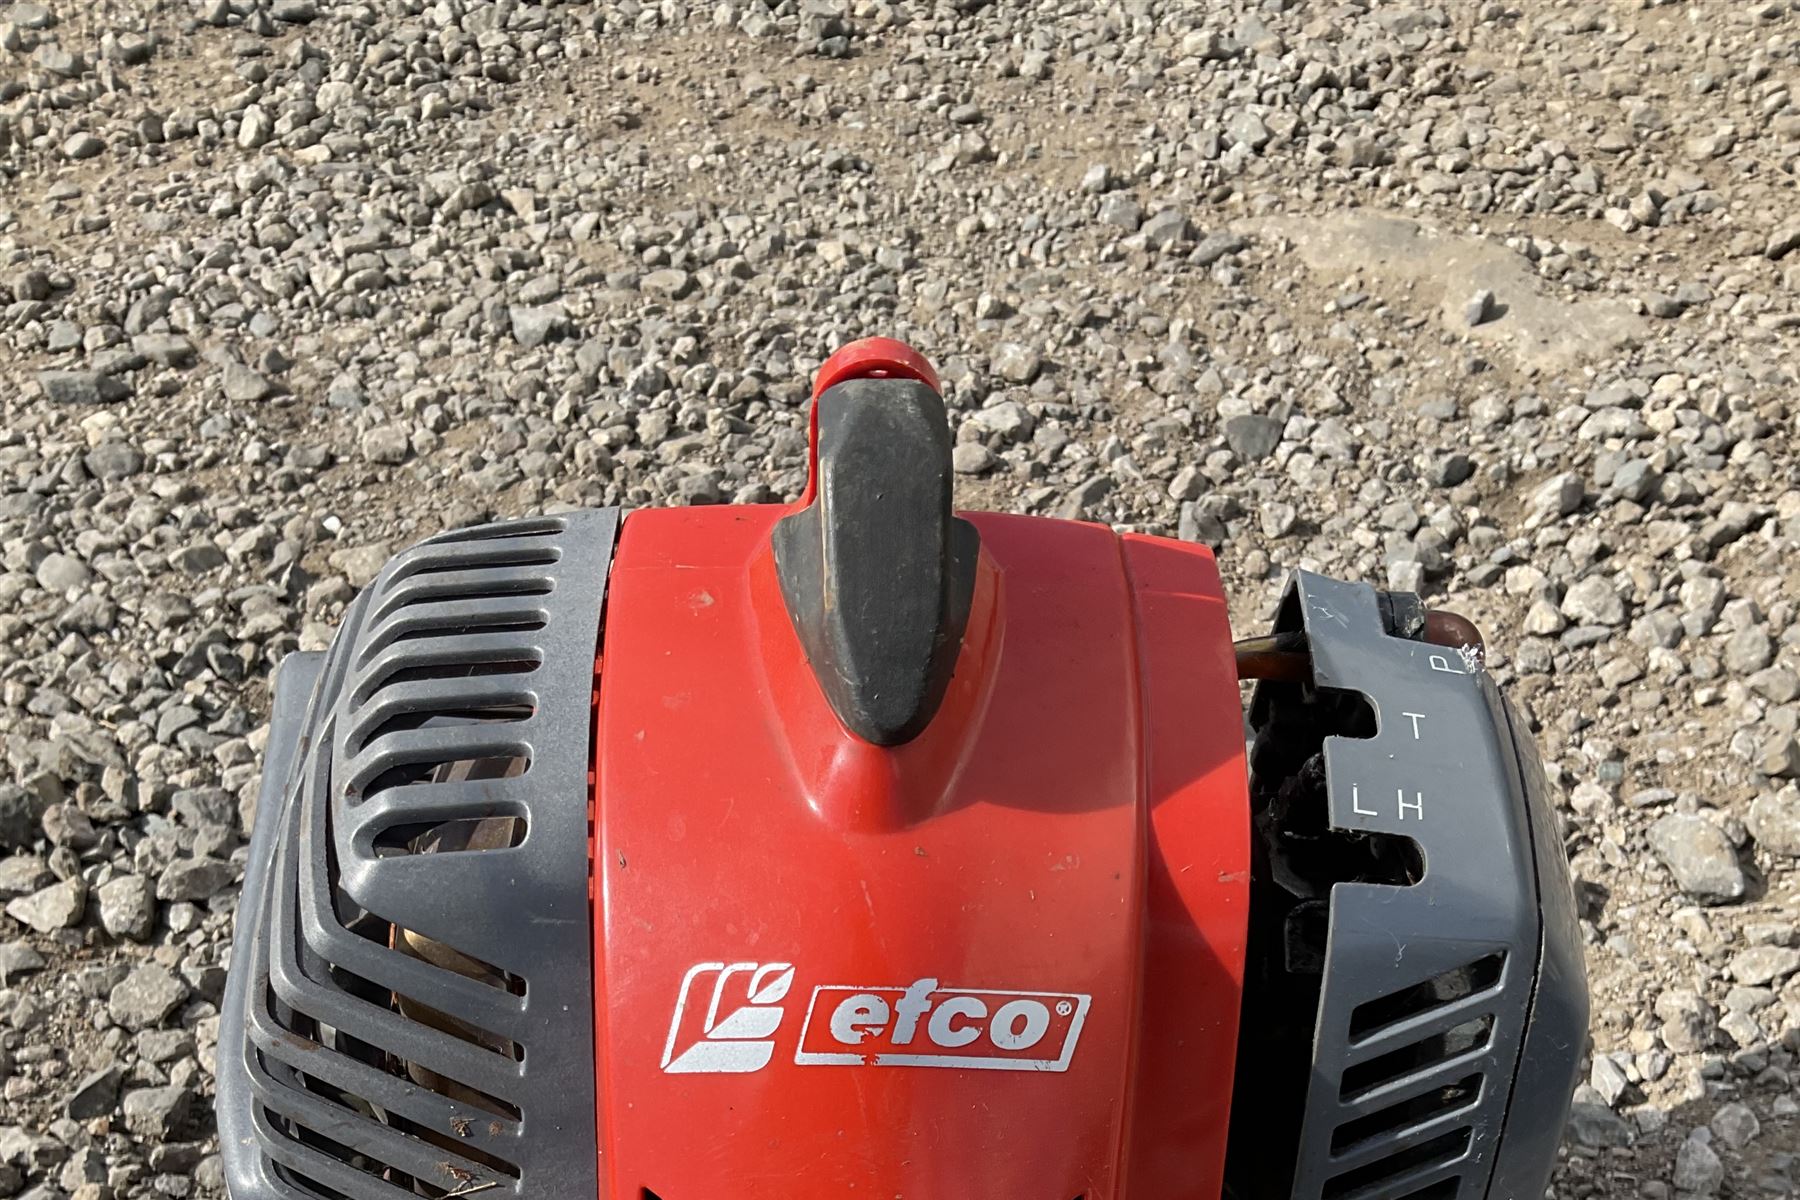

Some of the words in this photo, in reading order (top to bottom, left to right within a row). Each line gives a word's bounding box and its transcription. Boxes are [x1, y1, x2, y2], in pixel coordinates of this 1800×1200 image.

[1429, 655, 1467, 675] P
[1402, 711, 1426, 740] T
[1352, 783, 1378, 816] L
[1397, 789, 1423, 820] H
[829, 977, 1051, 1050] efco
